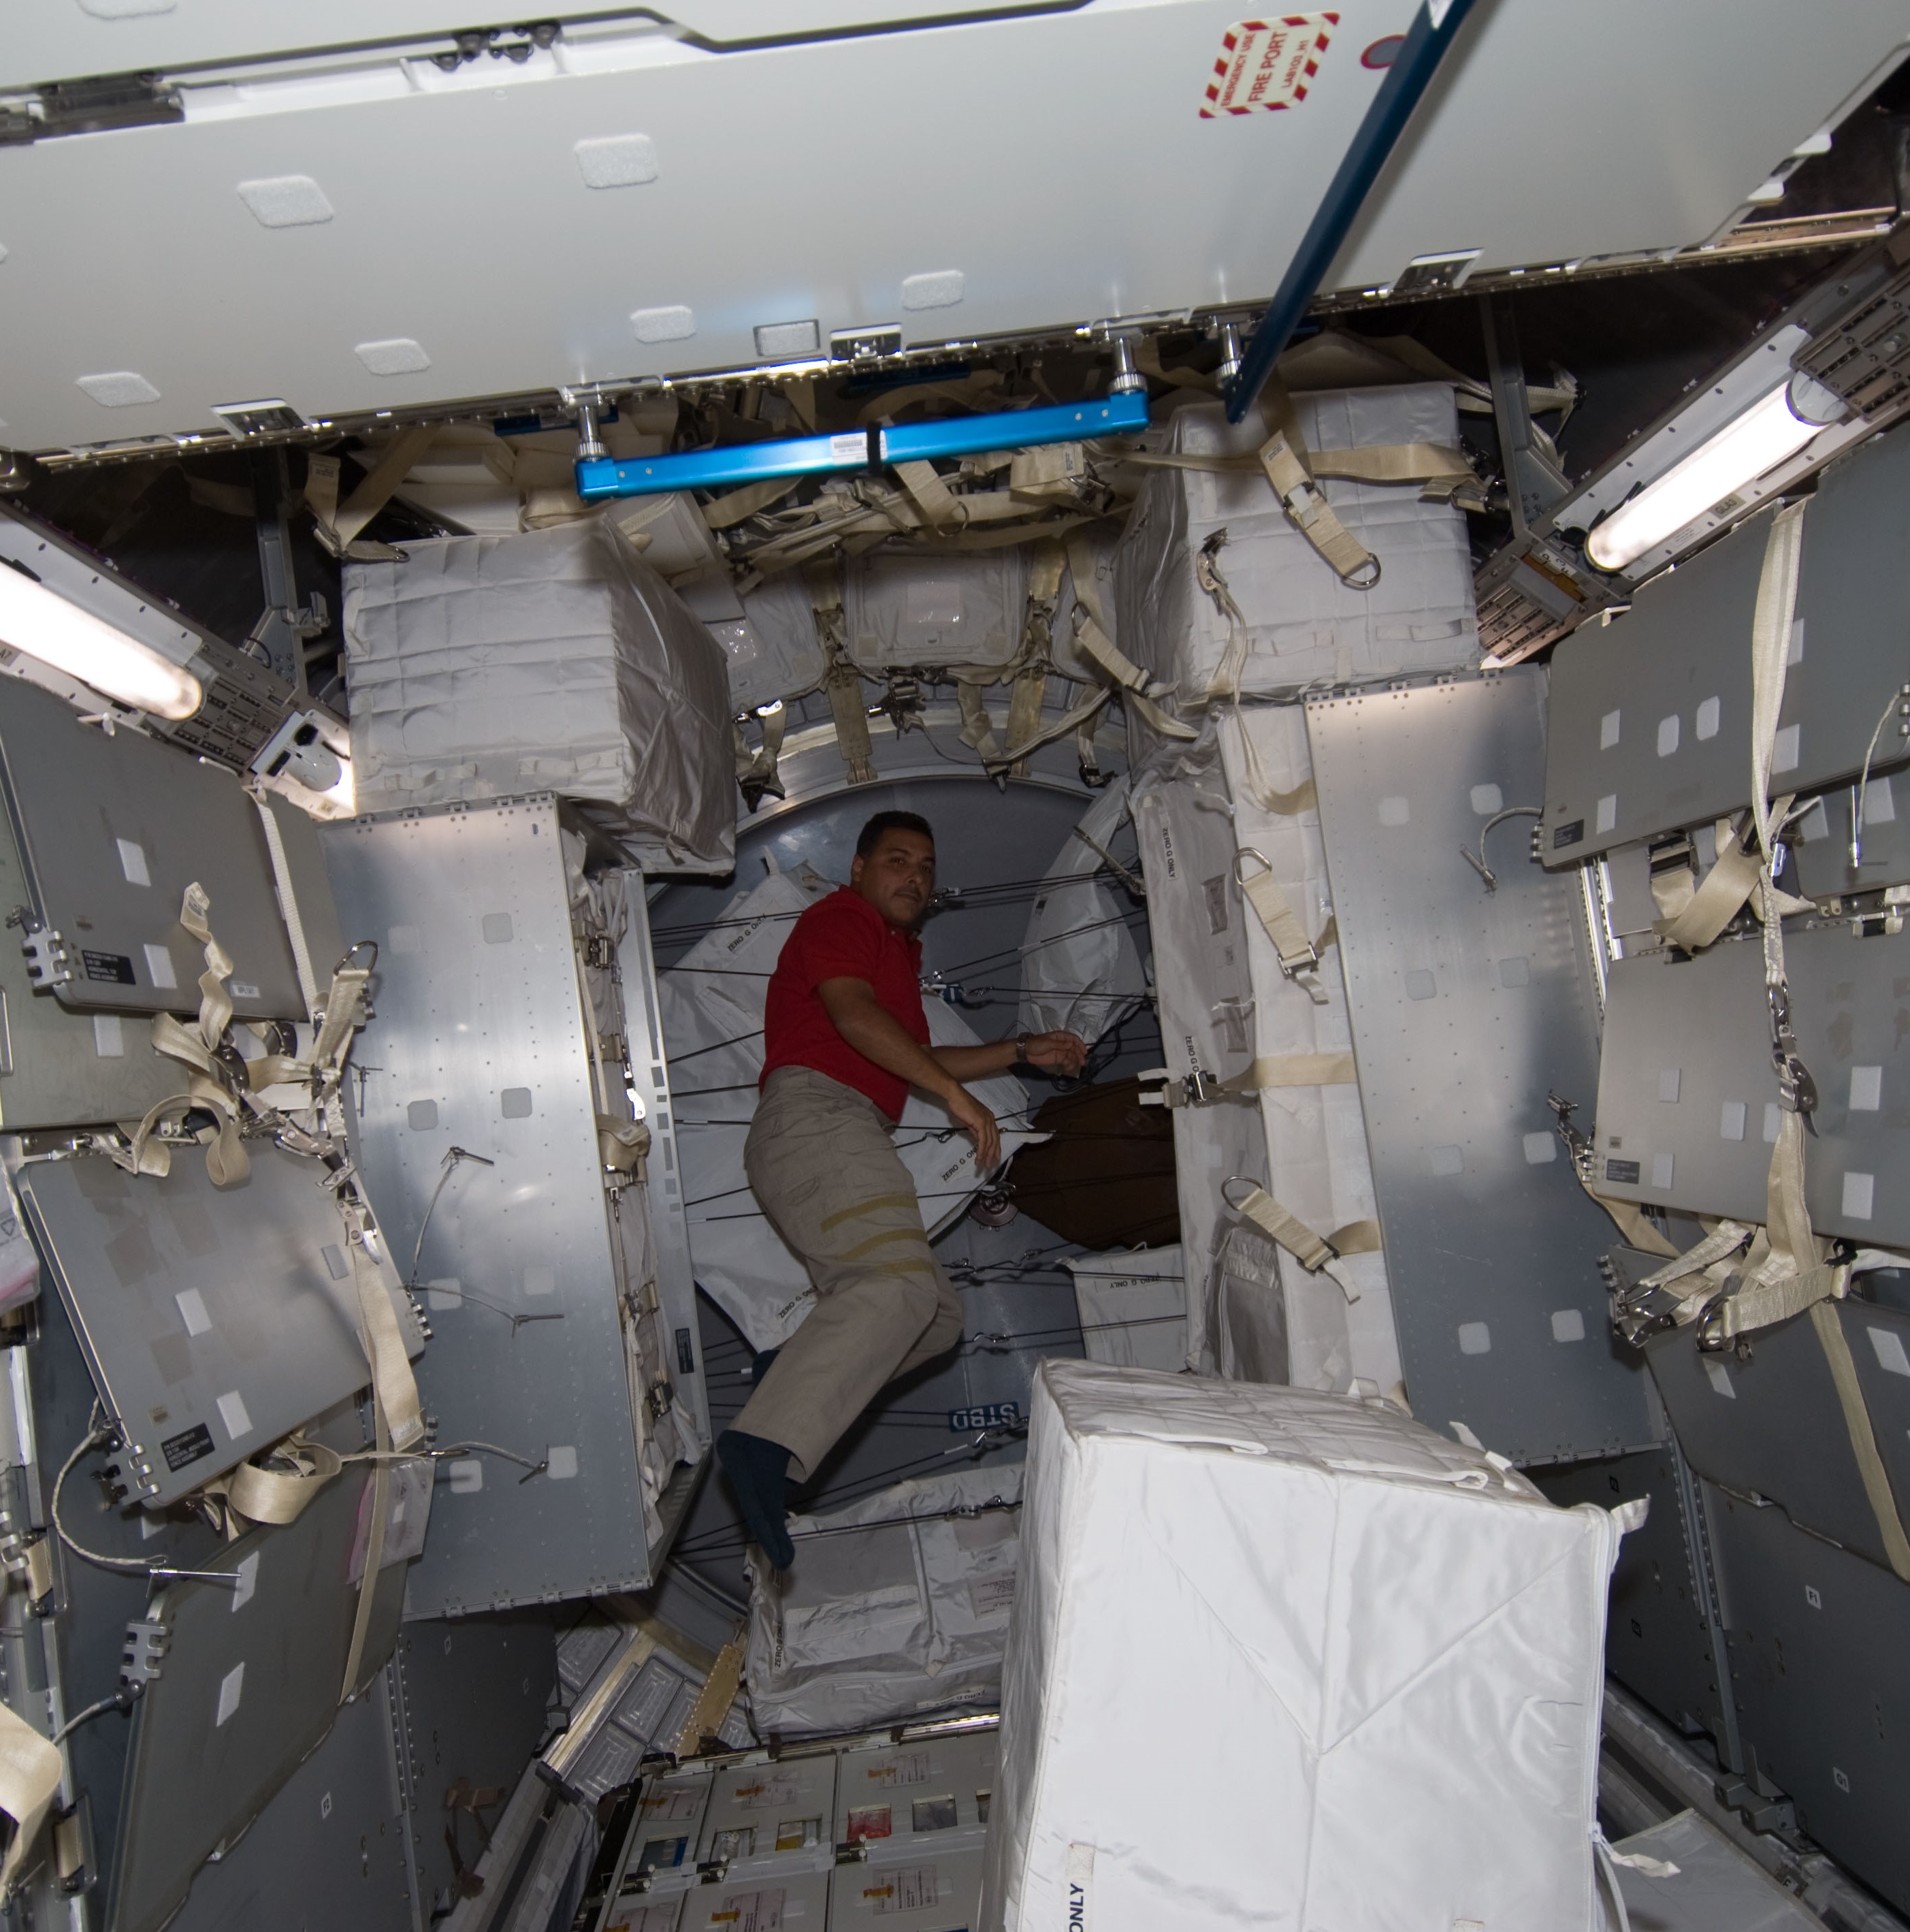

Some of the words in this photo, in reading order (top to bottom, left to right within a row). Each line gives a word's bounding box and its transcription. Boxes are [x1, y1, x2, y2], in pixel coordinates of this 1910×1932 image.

[1220, 54, 1247, 106] EMERGENCY
[1241, 32, 1256, 52] USE
[1248, 71, 1272, 102] FIRE
[1260, 31, 1288, 69] PORT
[1163, 827, 1171, 849] ZERO
[1167, 858, 1176, 878] ONLY
[728, 936, 744, 952] ZERO
[1186, 1035, 1195, 1057] ZERO
[942, 1164, 958, 1181] ZERO
[1110, 1281, 1128, 1289] ONLY
[778, 1302, 795, 1319] ZERO
[953, 1404, 1016, 1430] STBD
[1809, 1590, 1818, 1604] F1
[1836, 1772, 1847, 1788] G1
[1069, 1882, 1084, 1932] ONLY
